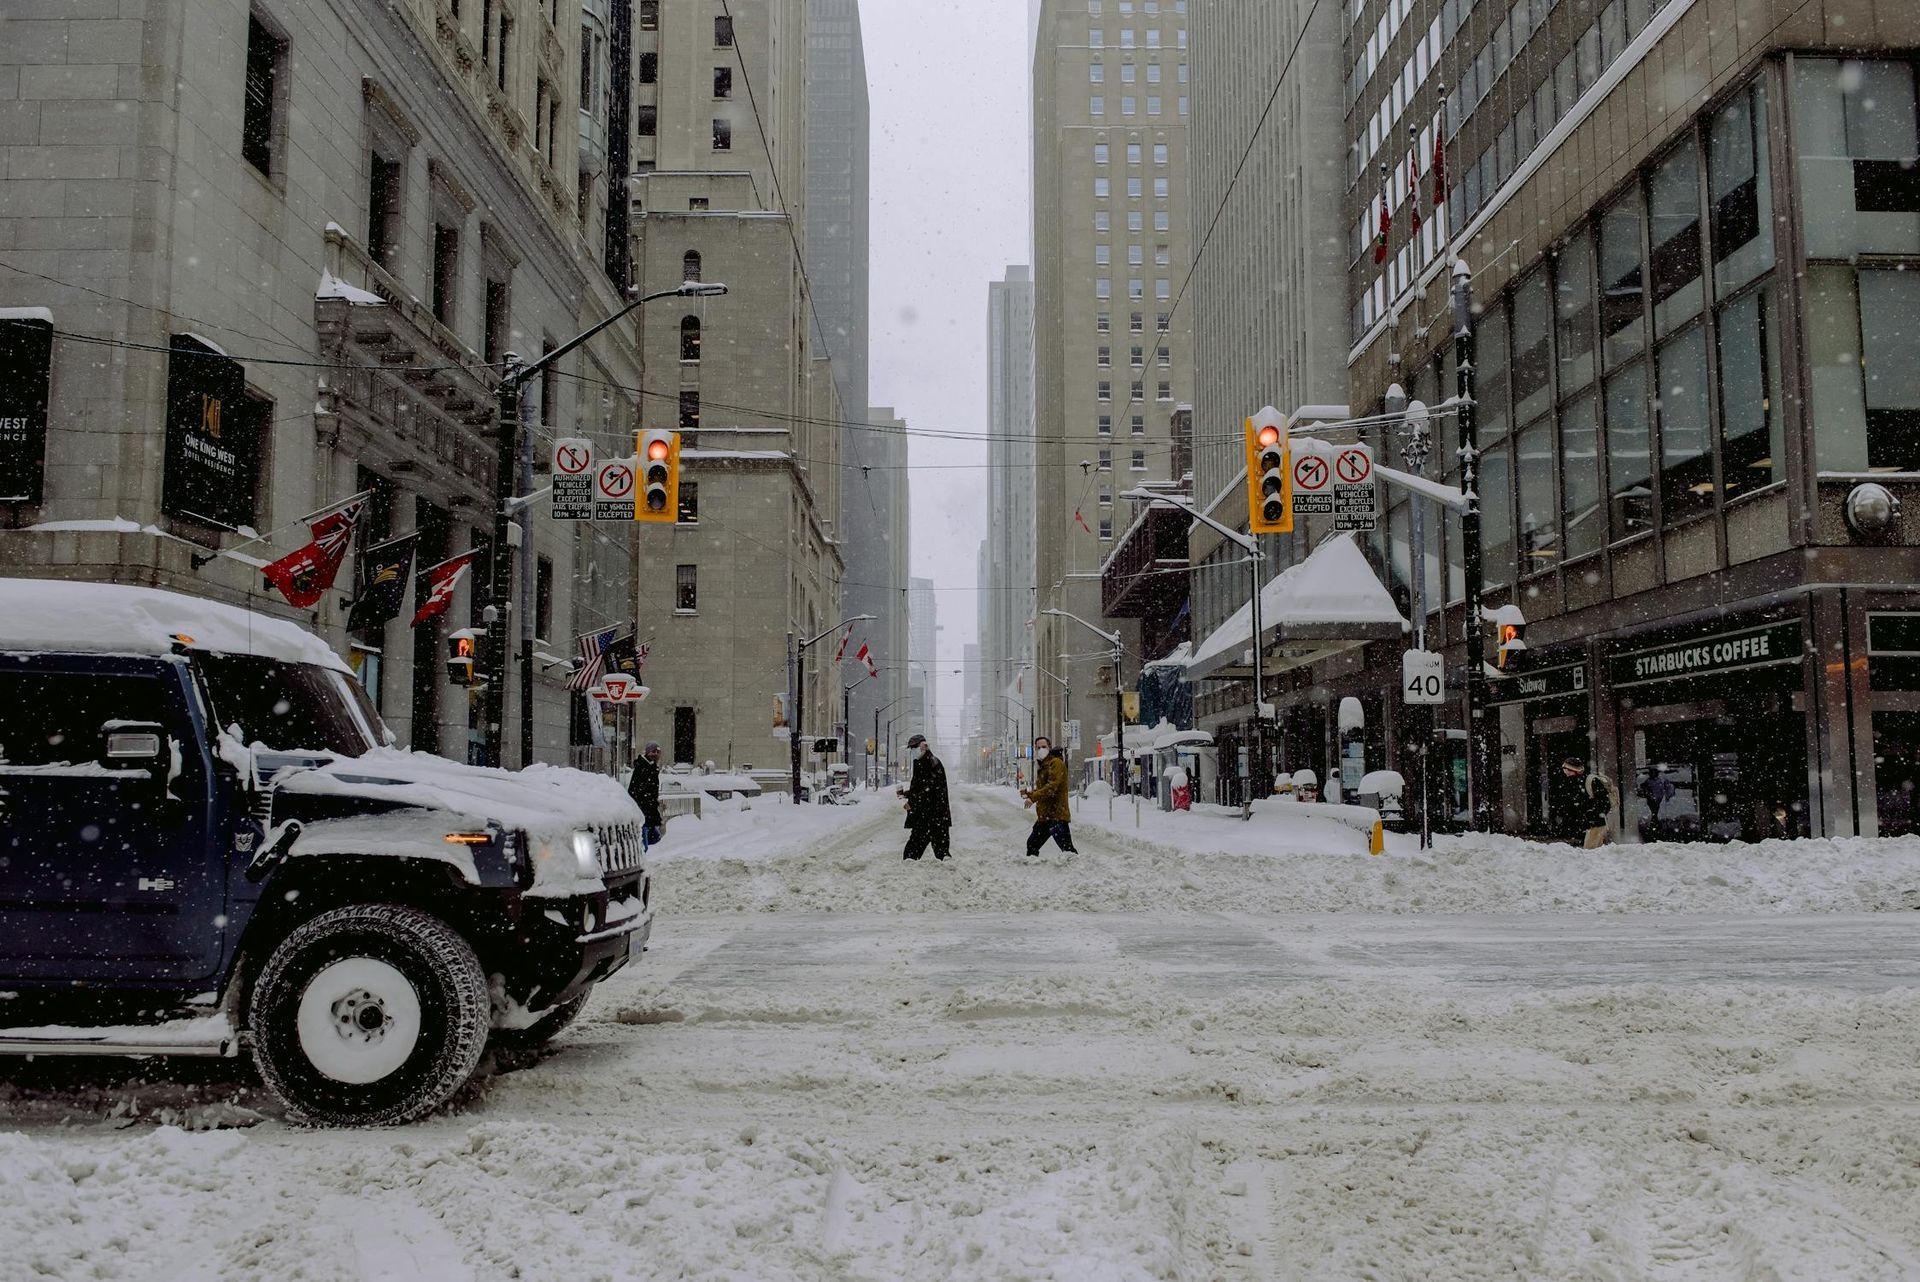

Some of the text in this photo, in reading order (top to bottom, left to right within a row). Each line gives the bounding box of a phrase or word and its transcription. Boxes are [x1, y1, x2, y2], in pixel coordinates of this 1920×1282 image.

[185, 434, 236, 466] ONE KING WEST
[558, 481, 587, 489] VEHICLES
[553, 488, 591, 496] AND BICYCLES
[1292, 496, 1332, 504] TTC VEHICLES
[1294, 504, 1331, 512] EXCEPTED
[1339, 505, 1370, 513] EXCEPTED
[1635, 635, 1770, 676] STARBUCKS COFFEE
[1407, 675, 1440, 696] 40
[1519, 678, 1547, 694] Subway
[138, 877, 175, 891] H2
